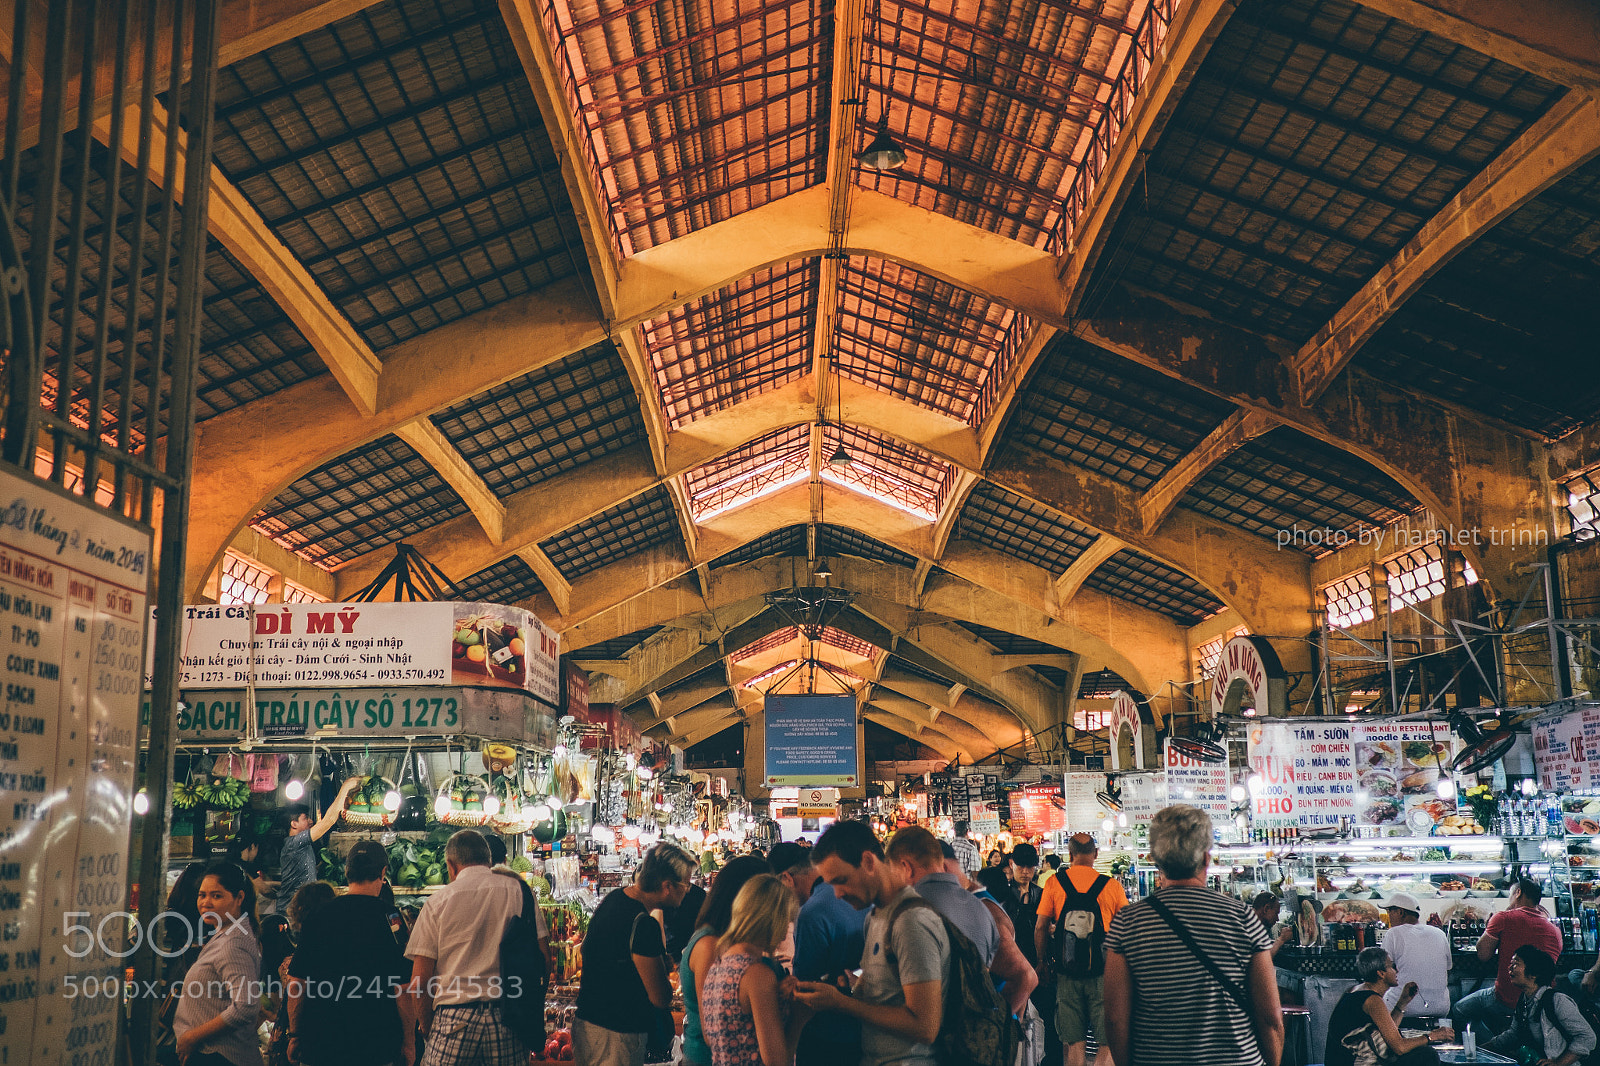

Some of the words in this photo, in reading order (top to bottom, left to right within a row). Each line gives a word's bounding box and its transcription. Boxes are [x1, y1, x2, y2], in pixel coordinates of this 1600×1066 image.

[86, 538, 115, 564] năm
[186, 607, 221, 619] Trái
[255, 607, 293, 634] DÌ
[306, 607, 361, 634] MỸ
[267, 638, 289, 649] Trái
[292, 638, 309, 650] cây
[312, 637, 328, 650] nội
[331, 638, 341, 647] &
[345, 637, 374, 650] ngoại
[377, 637, 404, 650] nhập
[208, 653, 224, 666] kết
[267, 654, 285, 667] cây
[295, 654, 320, 665] Đám
[324, 653, 349, 664] Cưới
[359, 653, 383, 664] Sinh
[386, 653, 412, 666] Nhật
[200, 672, 224, 682] 1273
[261, 671, 291, 684] thoại:
[294, 670, 368, 681] 0122.998.9654
[377, 669, 445, 680] 0933.570.492
[1214, 660, 1228, 706] KHU
[255, 693, 310, 729] TRÁI
[314, 692, 360, 729] CÂY
[363, 692, 397, 728] SỐ
[401, 697, 458, 727] 1273
[1294, 726, 1315, 740] TẤM
[1324, 727, 1350, 740] SƯỜN
[1366, 733, 1399, 741] noodle
[1402, 733, 1410, 741] &
[1413, 733, 1432, 741] rice
[1318, 772, 1336, 781] CANH
[1256, 790, 1293, 814] PHỞ
[1325, 814, 1339, 825] NAM
